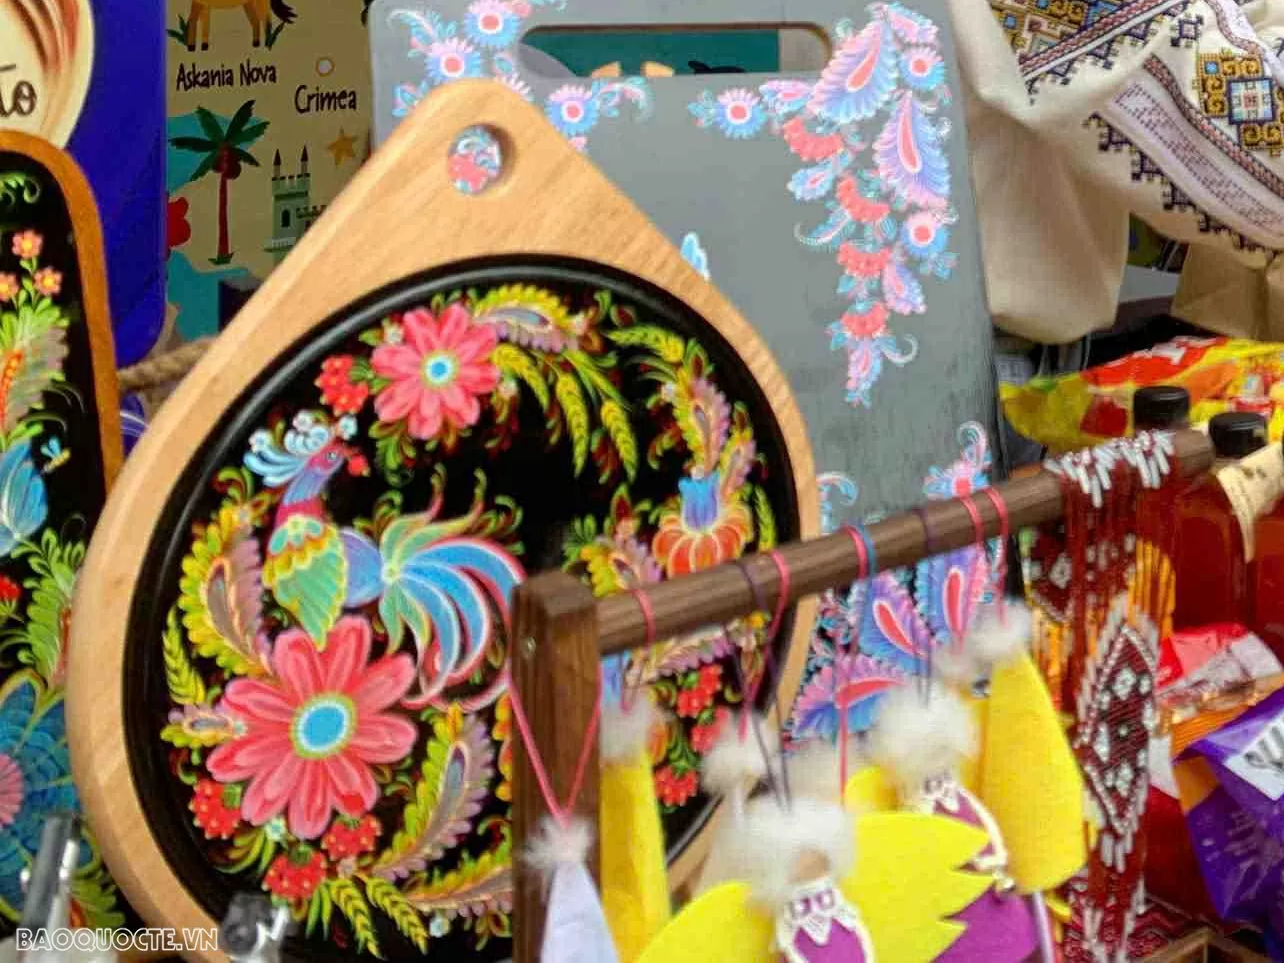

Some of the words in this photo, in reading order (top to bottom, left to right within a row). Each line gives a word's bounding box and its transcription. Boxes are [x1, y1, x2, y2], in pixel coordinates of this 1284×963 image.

[176, 63, 234, 91] Askania
[239, 63, 278, 87] Nova
[293, 85, 358, 114] Crimea
